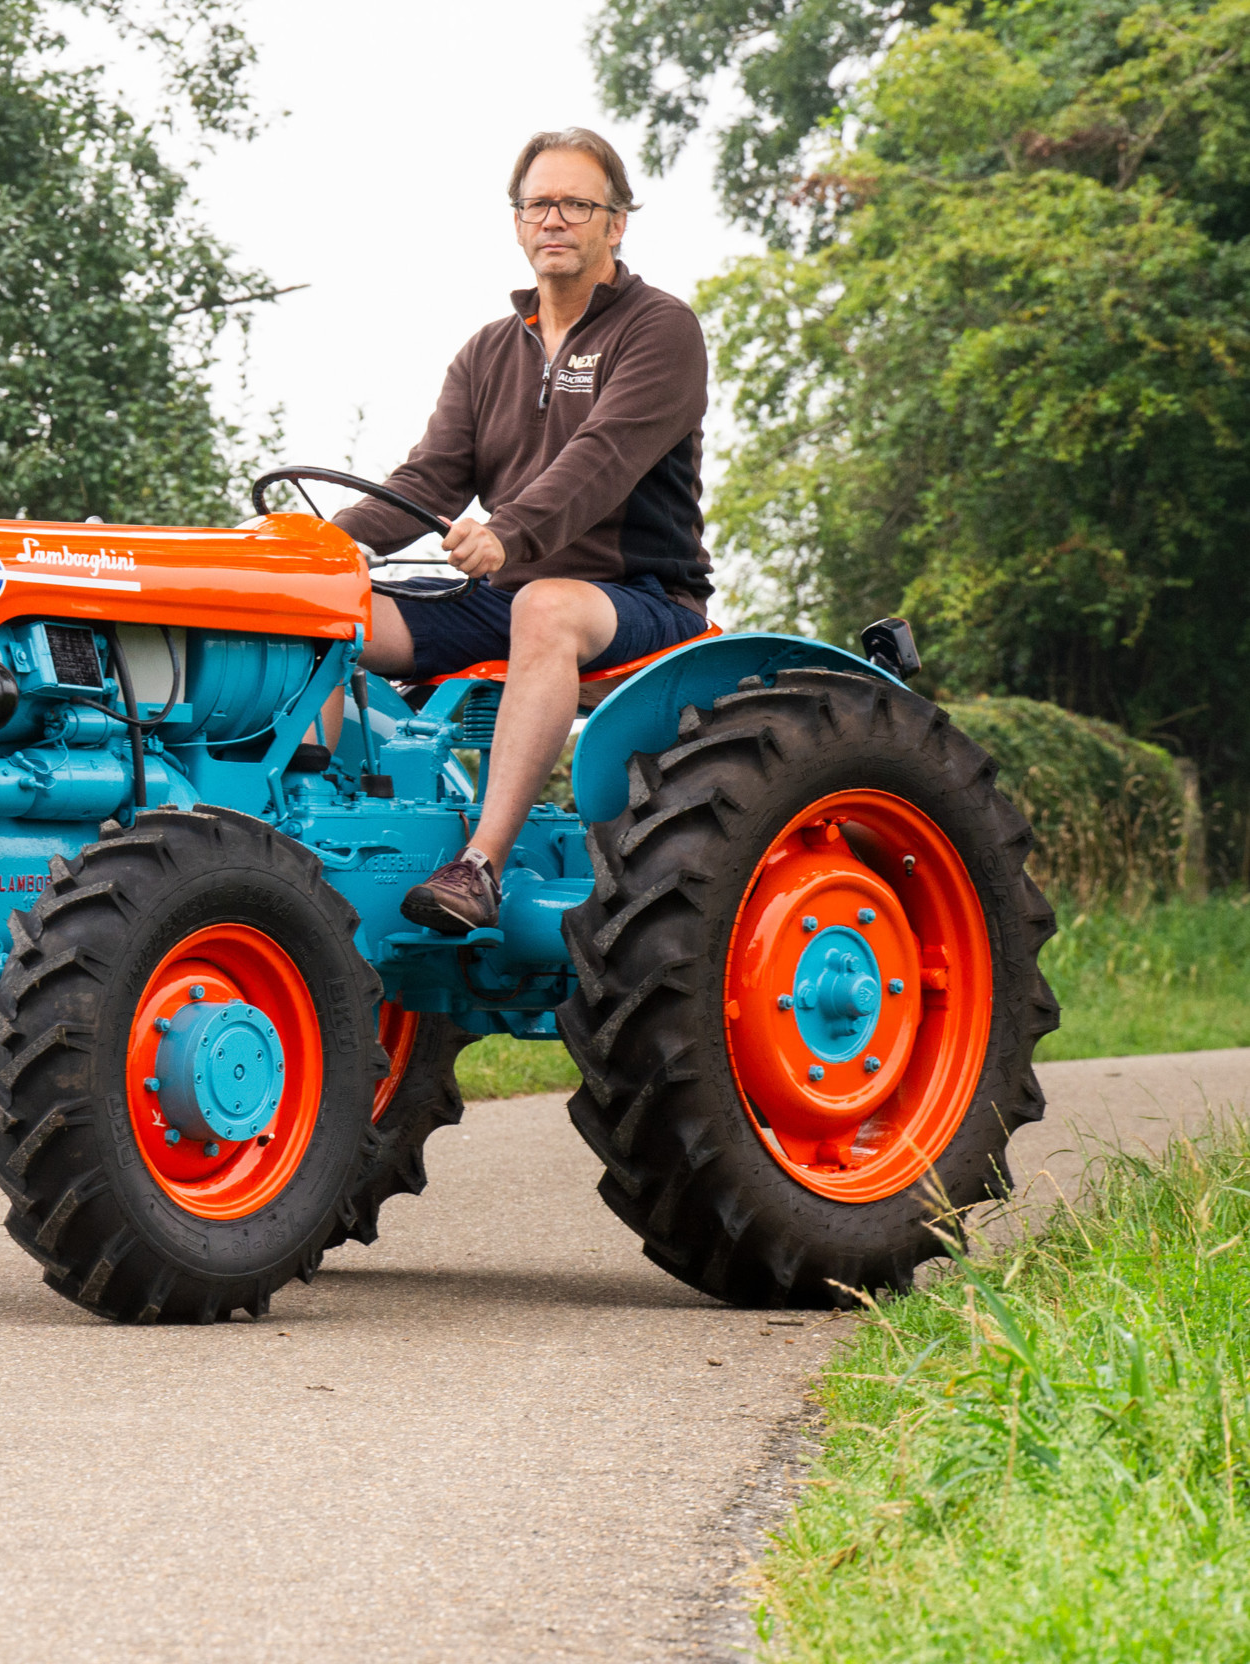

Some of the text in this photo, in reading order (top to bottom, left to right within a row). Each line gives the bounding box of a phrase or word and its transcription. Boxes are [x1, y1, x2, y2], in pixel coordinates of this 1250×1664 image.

[567, 352, 602, 369] NEXT
[558, 373, 593, 384] AUCTIONS
[16, 537, 137, 577] Lamborghini
